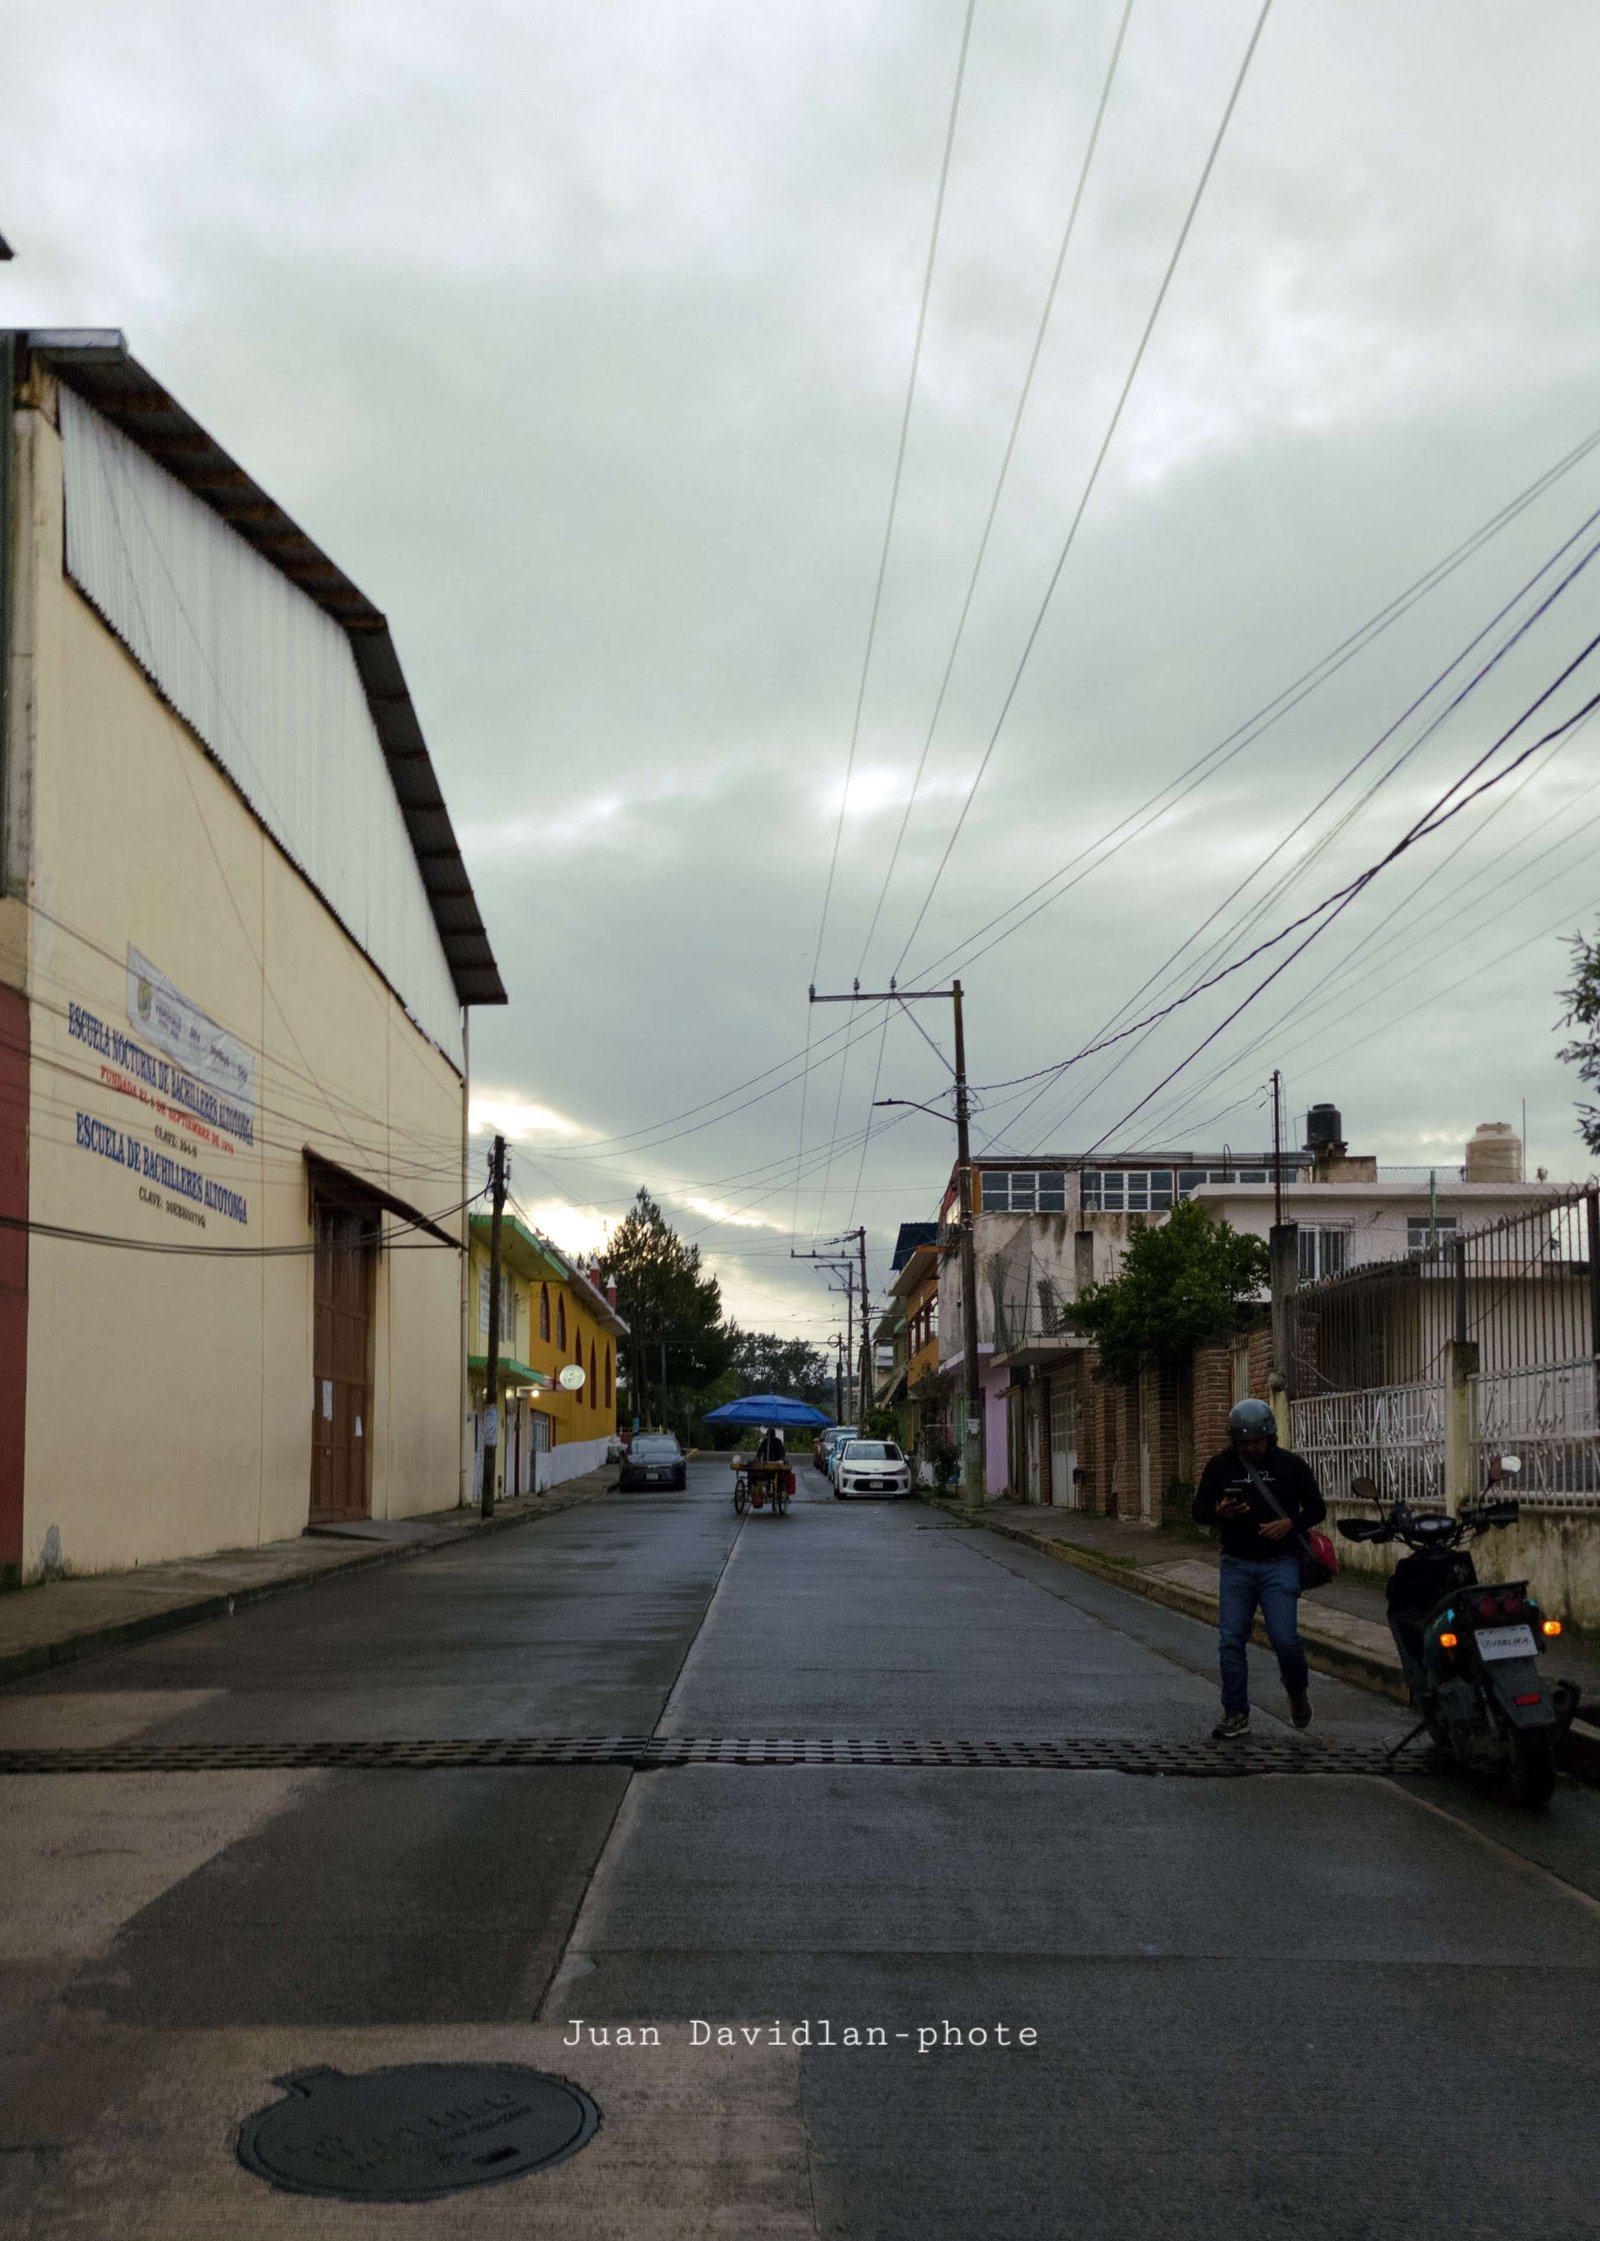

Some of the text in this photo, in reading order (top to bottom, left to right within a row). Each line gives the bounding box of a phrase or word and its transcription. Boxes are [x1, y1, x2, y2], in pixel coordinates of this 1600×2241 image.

[69, 1001, 109, 1058] ESCUELA
[109, 1025, 156, 1087] NOCTURNA
[159, 1060, 169, 1094] DE
[76, 1112, 248, 1225] ESCUELA DE BACHILLERES ALTOTONGA
